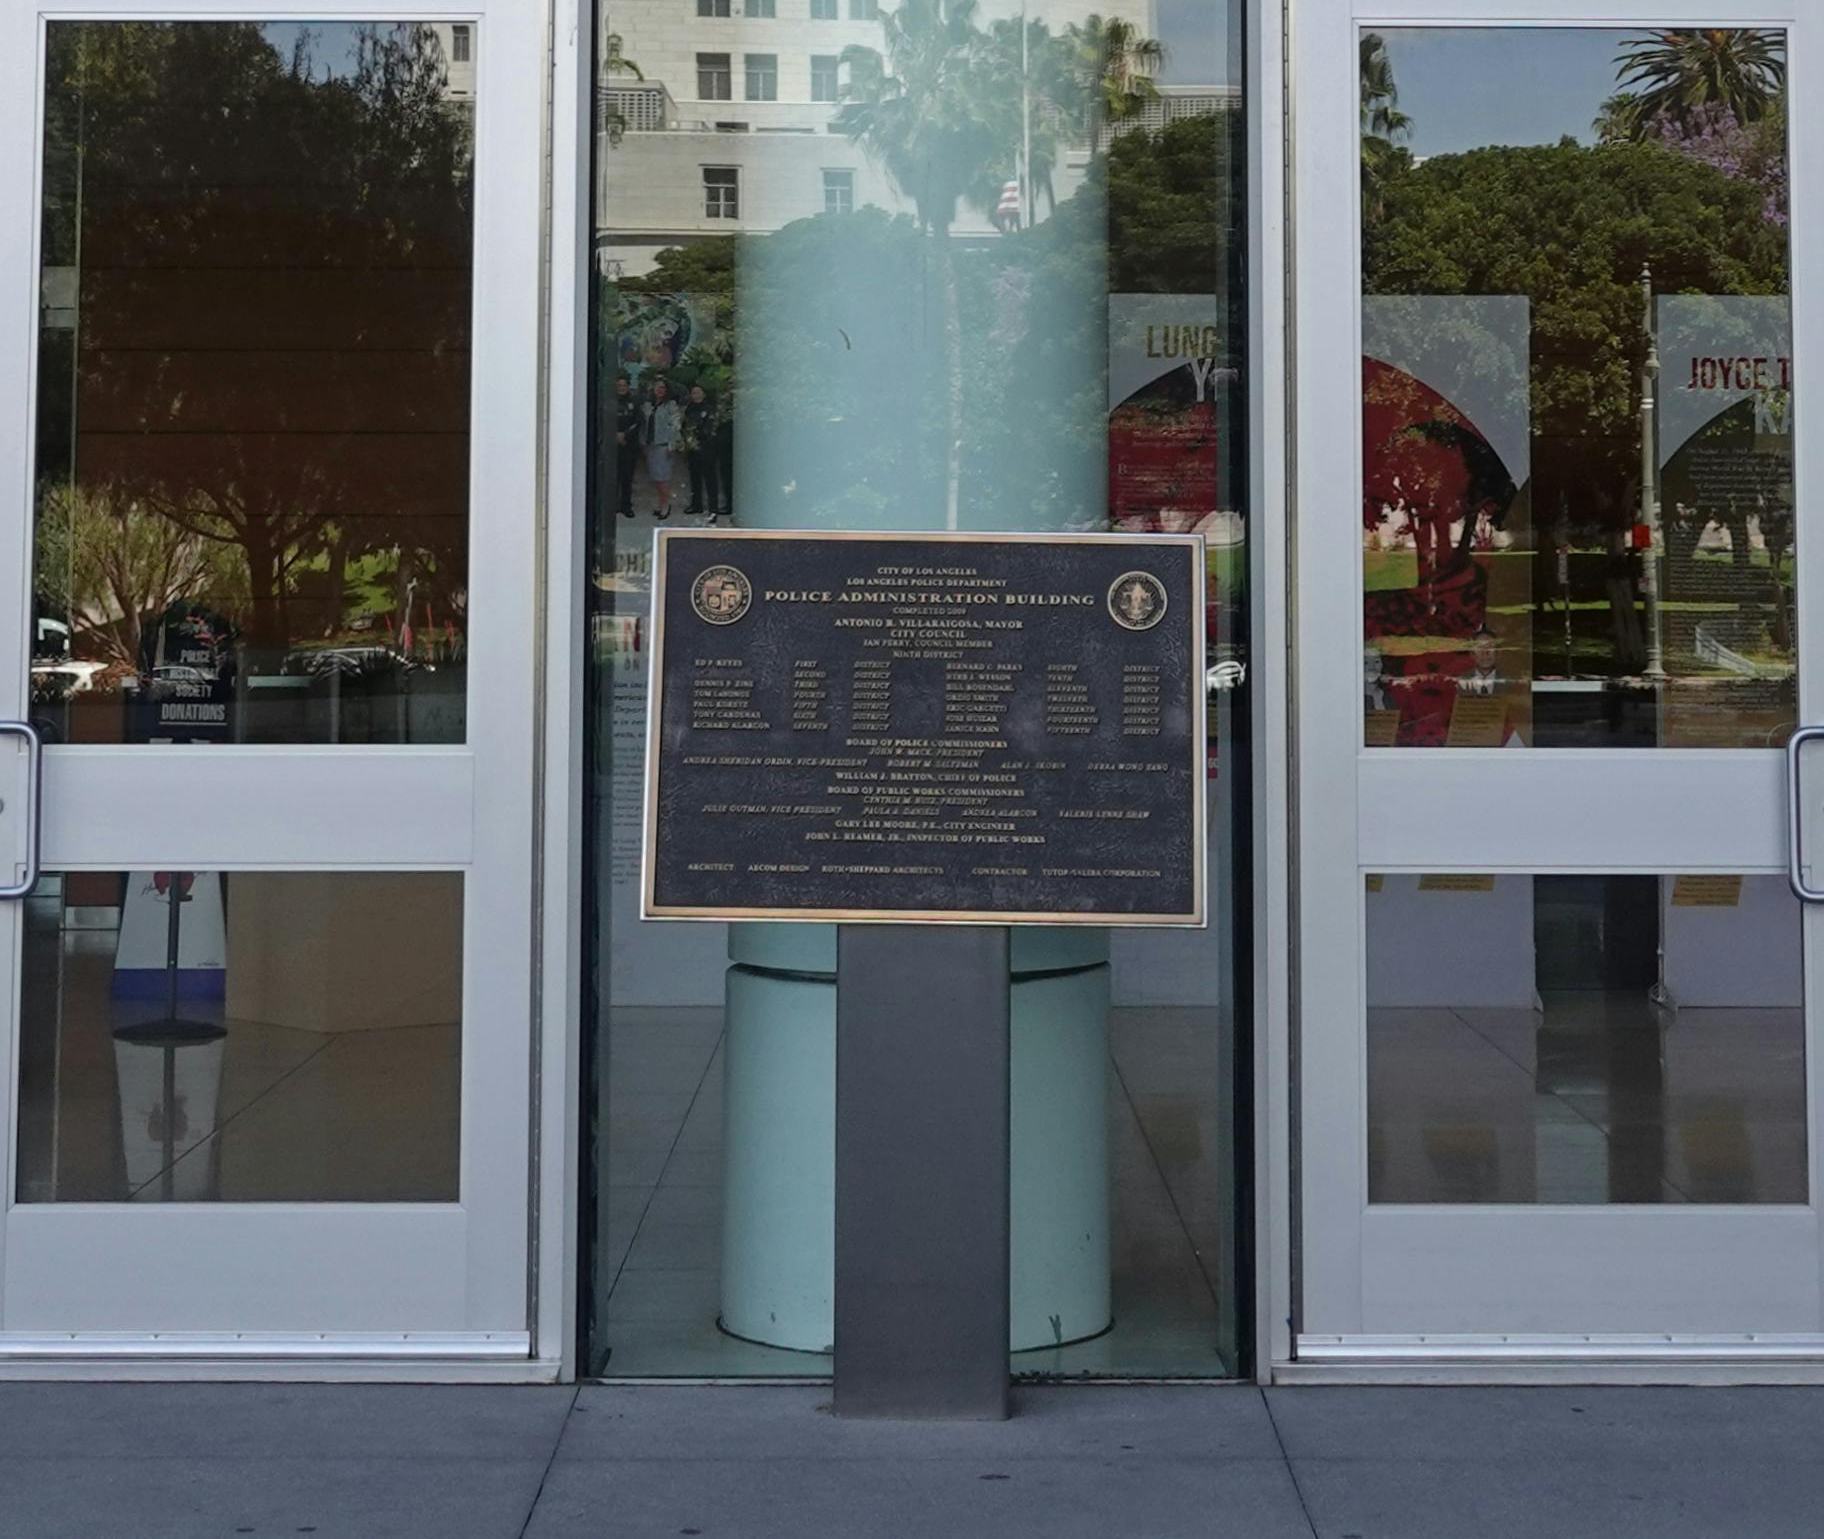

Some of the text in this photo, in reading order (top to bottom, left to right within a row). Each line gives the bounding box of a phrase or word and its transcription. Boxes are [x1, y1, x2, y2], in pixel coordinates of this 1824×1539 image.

[1687, 357, 1768, 390] JOYCE
[936, 568, 977, 576] ANGELES
[847, 578, 1007, 588] LOS ANGELES POLICE DEPARTMENT
[764, 591, 1095, 606] POLICE ADMINISTRATION BUILDING
[835, 619, 884, 628] ANTONIO
[899, 619, 982, 629] VILLARAIGOSA,
[986, 621, 1024, 629] MAYOR
[891, 630, 968, 639] CITY COUNCIL
[180, 649, 211, 663] POLICE
[175, 683, 213, 698] SOCIETY
[161, 703, 226, 721] DONATIONS
[880, 739, 893, 747] OF
[895, 739, 929, 747] POLICE
[931, 740, 1008, 749] COMMISSIONERS
